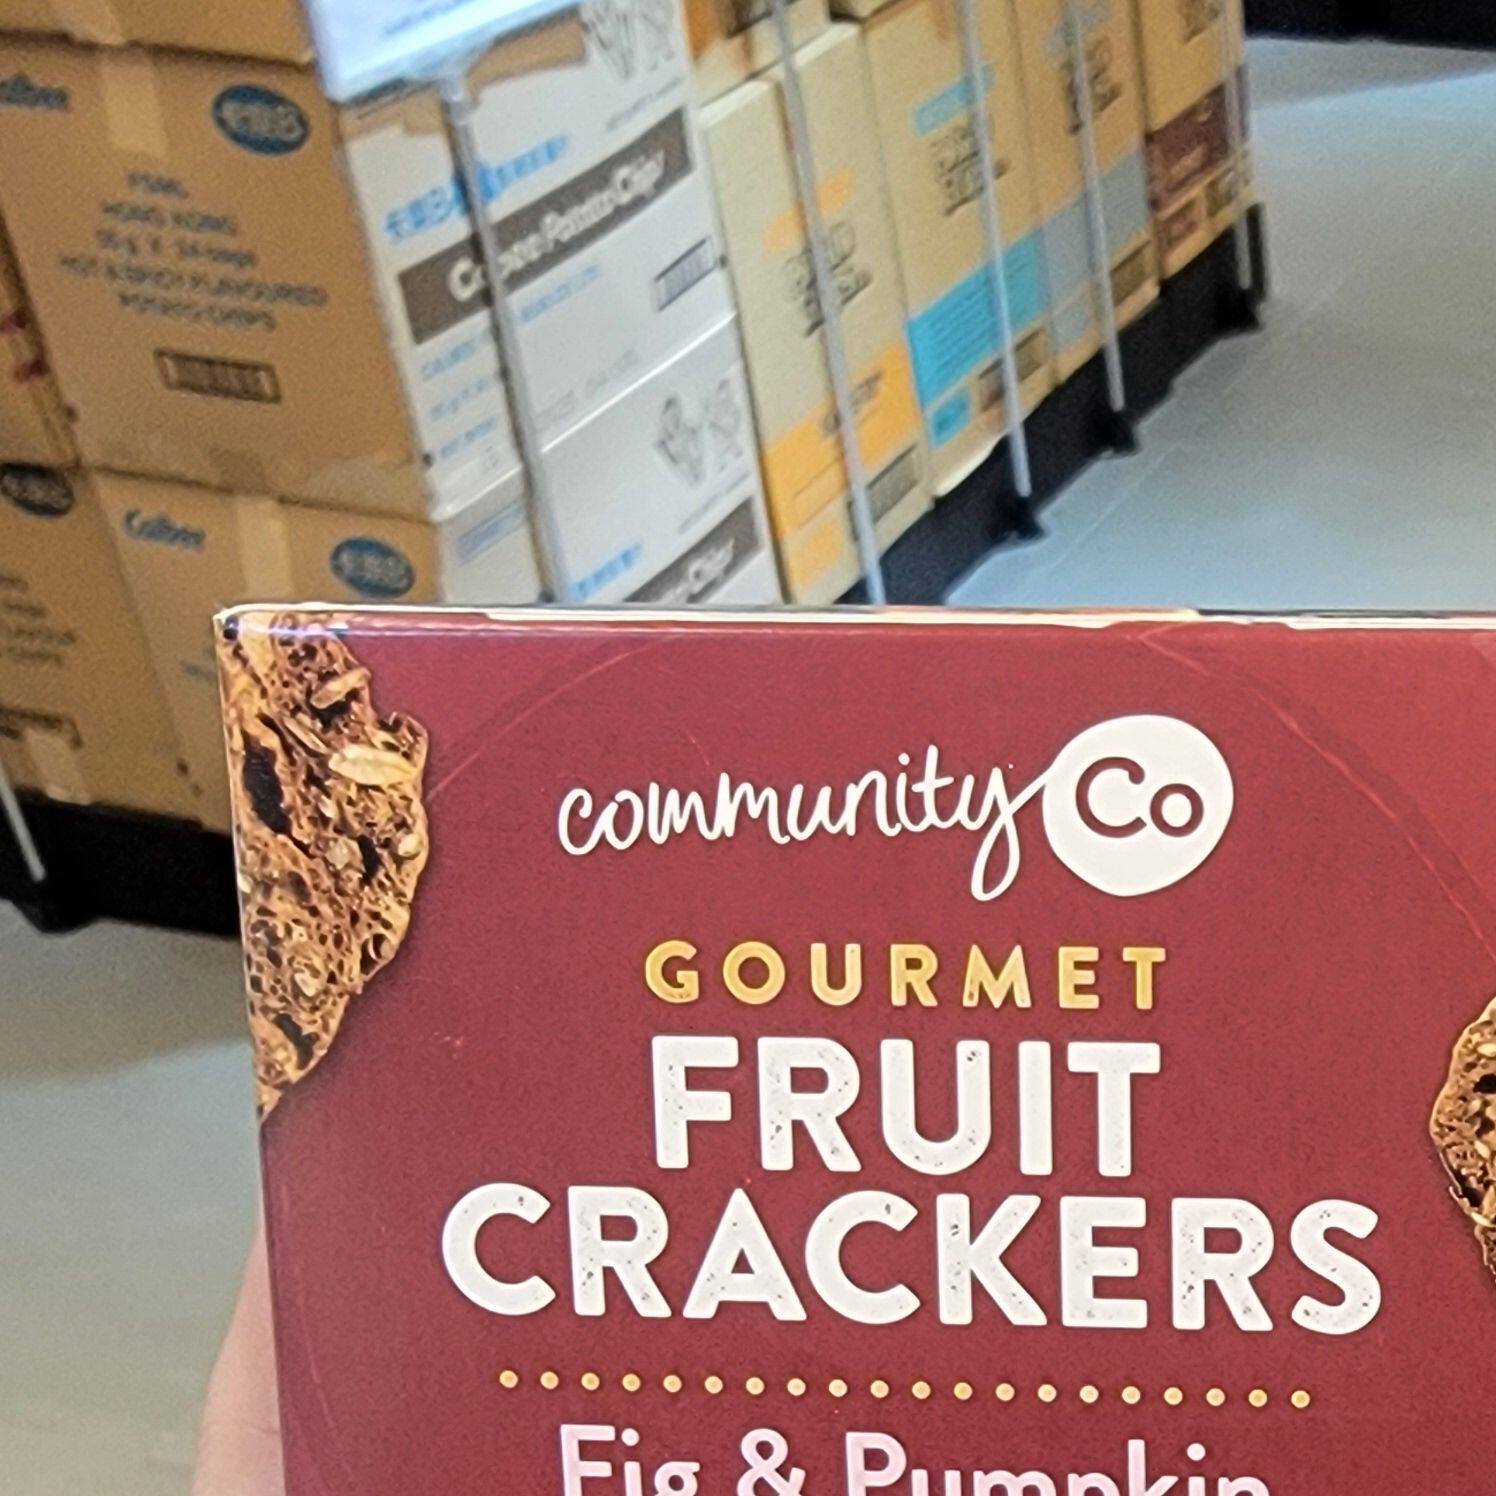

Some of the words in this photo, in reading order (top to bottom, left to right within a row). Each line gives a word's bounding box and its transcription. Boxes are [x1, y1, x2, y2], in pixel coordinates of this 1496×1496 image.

[558, 744, 1048, 901] community
[1074, 756, 1205, 838] Co
[645, 940, 1166, 1010] GOURMET
[652, 1035, 1161, 1177] FRUIT
[441, 1183, 1381, 1335] CRACKERS
